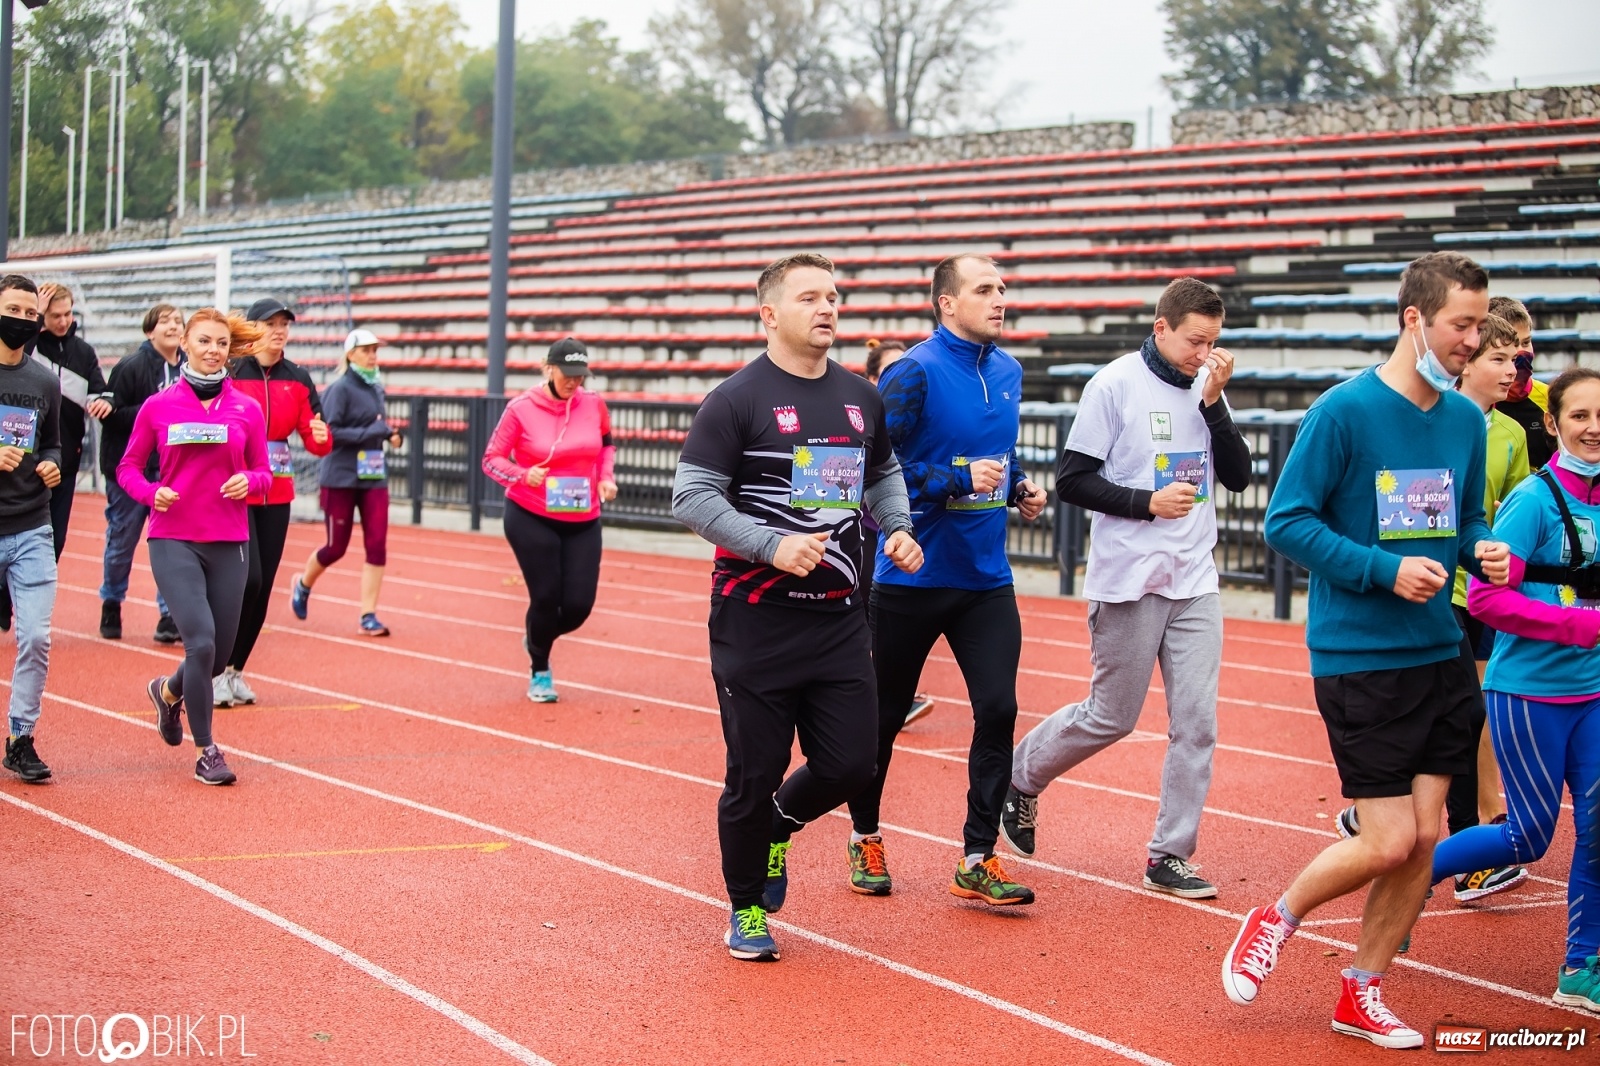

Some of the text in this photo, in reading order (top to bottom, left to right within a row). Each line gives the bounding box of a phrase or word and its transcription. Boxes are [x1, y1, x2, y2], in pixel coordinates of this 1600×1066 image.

[11, 437, 29, 447] 275
[839, 489, 857, 502] 219
[1388, 494, 1404, 503] BIEG
[1407, 494, 1420, 502] DLA
[1427, 515, 1449, 528] 013
